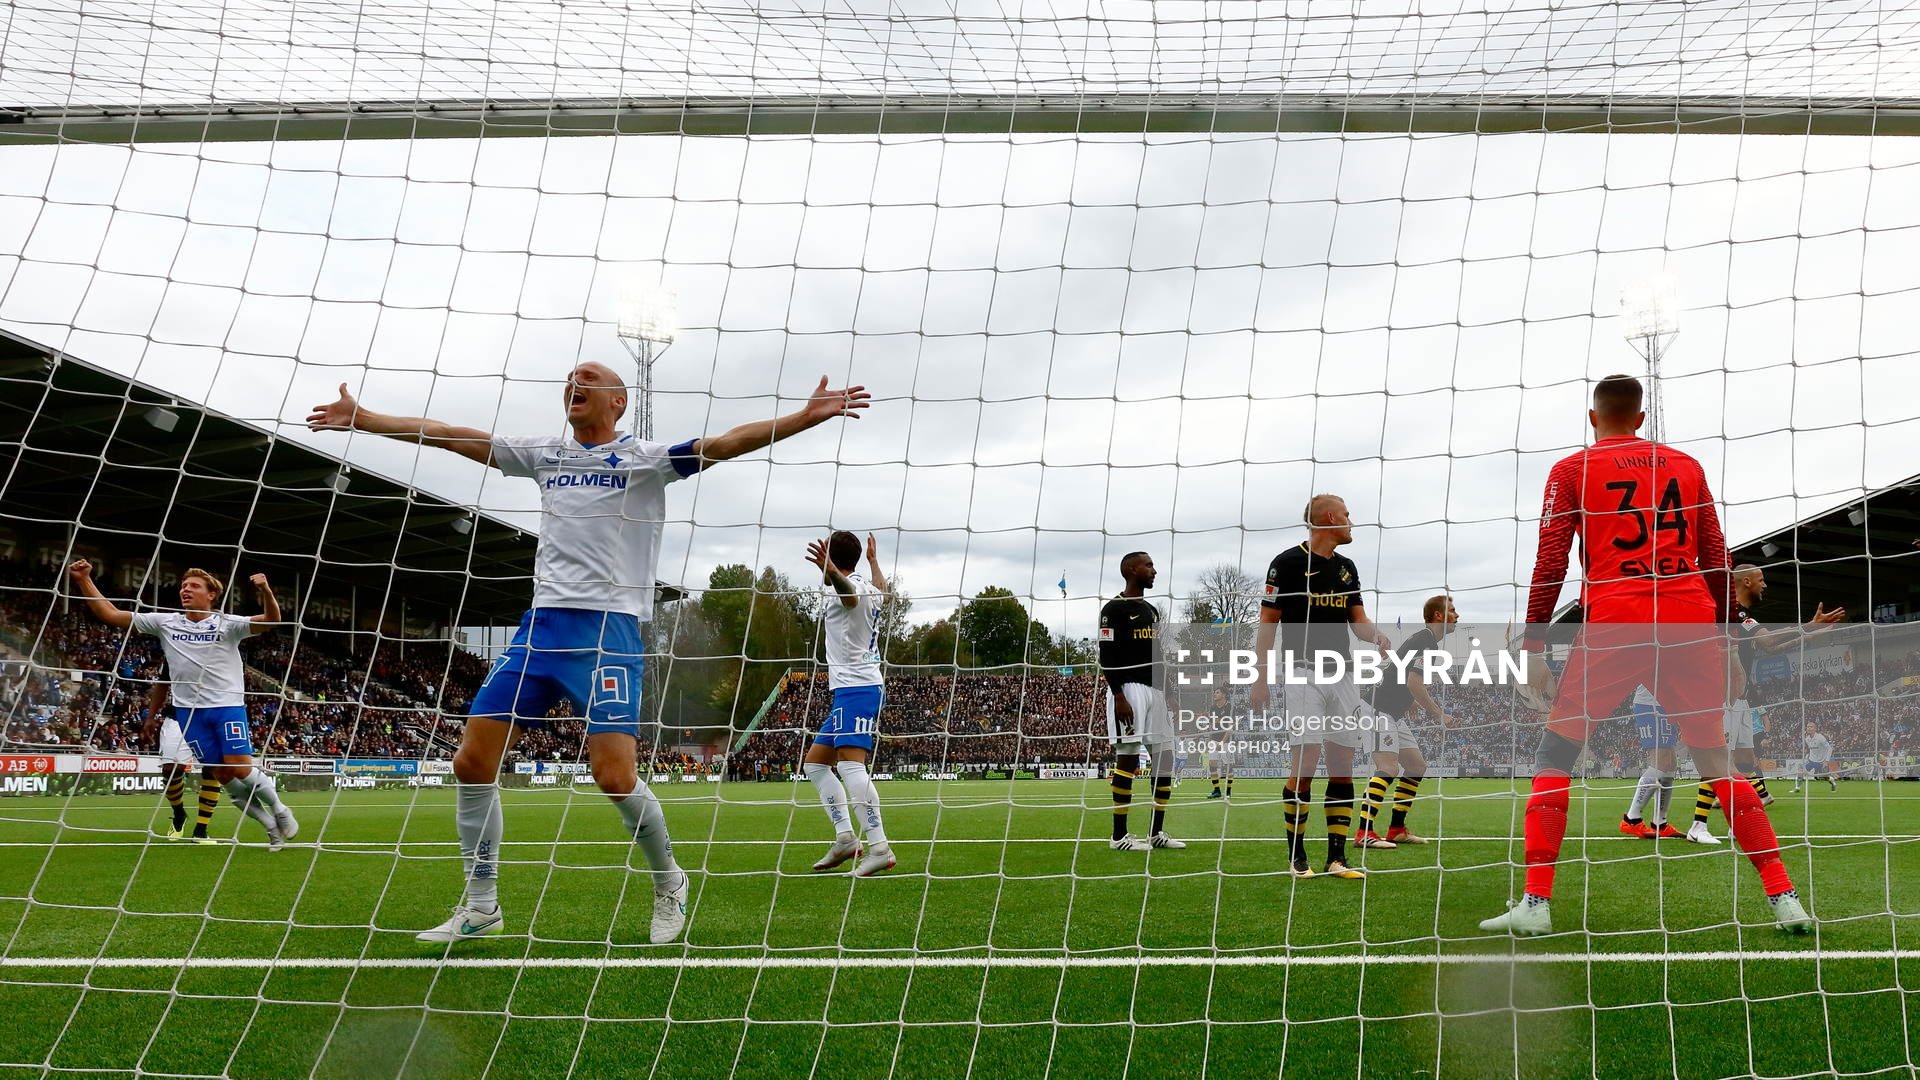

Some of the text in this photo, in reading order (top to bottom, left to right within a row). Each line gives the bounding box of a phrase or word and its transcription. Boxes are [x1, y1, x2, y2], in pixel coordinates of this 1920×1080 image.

[546, 474, 627, 489] HOLMEN
[1605, 477, 1688, 550] 34
[1619, 557, 1691, 577] SVEA
[1310, 590, 1348, 608] notar
[172, 633, 221, 642] HOLMEN
[1791, 657, 1817, 673] Svnska
[8, 759, 28, 771] AB
[84, 758, 137, 771] KONTORAB
[531, 775, 557, 784] HOLMEN
[1233, 769, 1282, 777] HOLMEN
[112, 776, 165, 791] HOLME
[334, 776, 376, 787] HOLMEN
